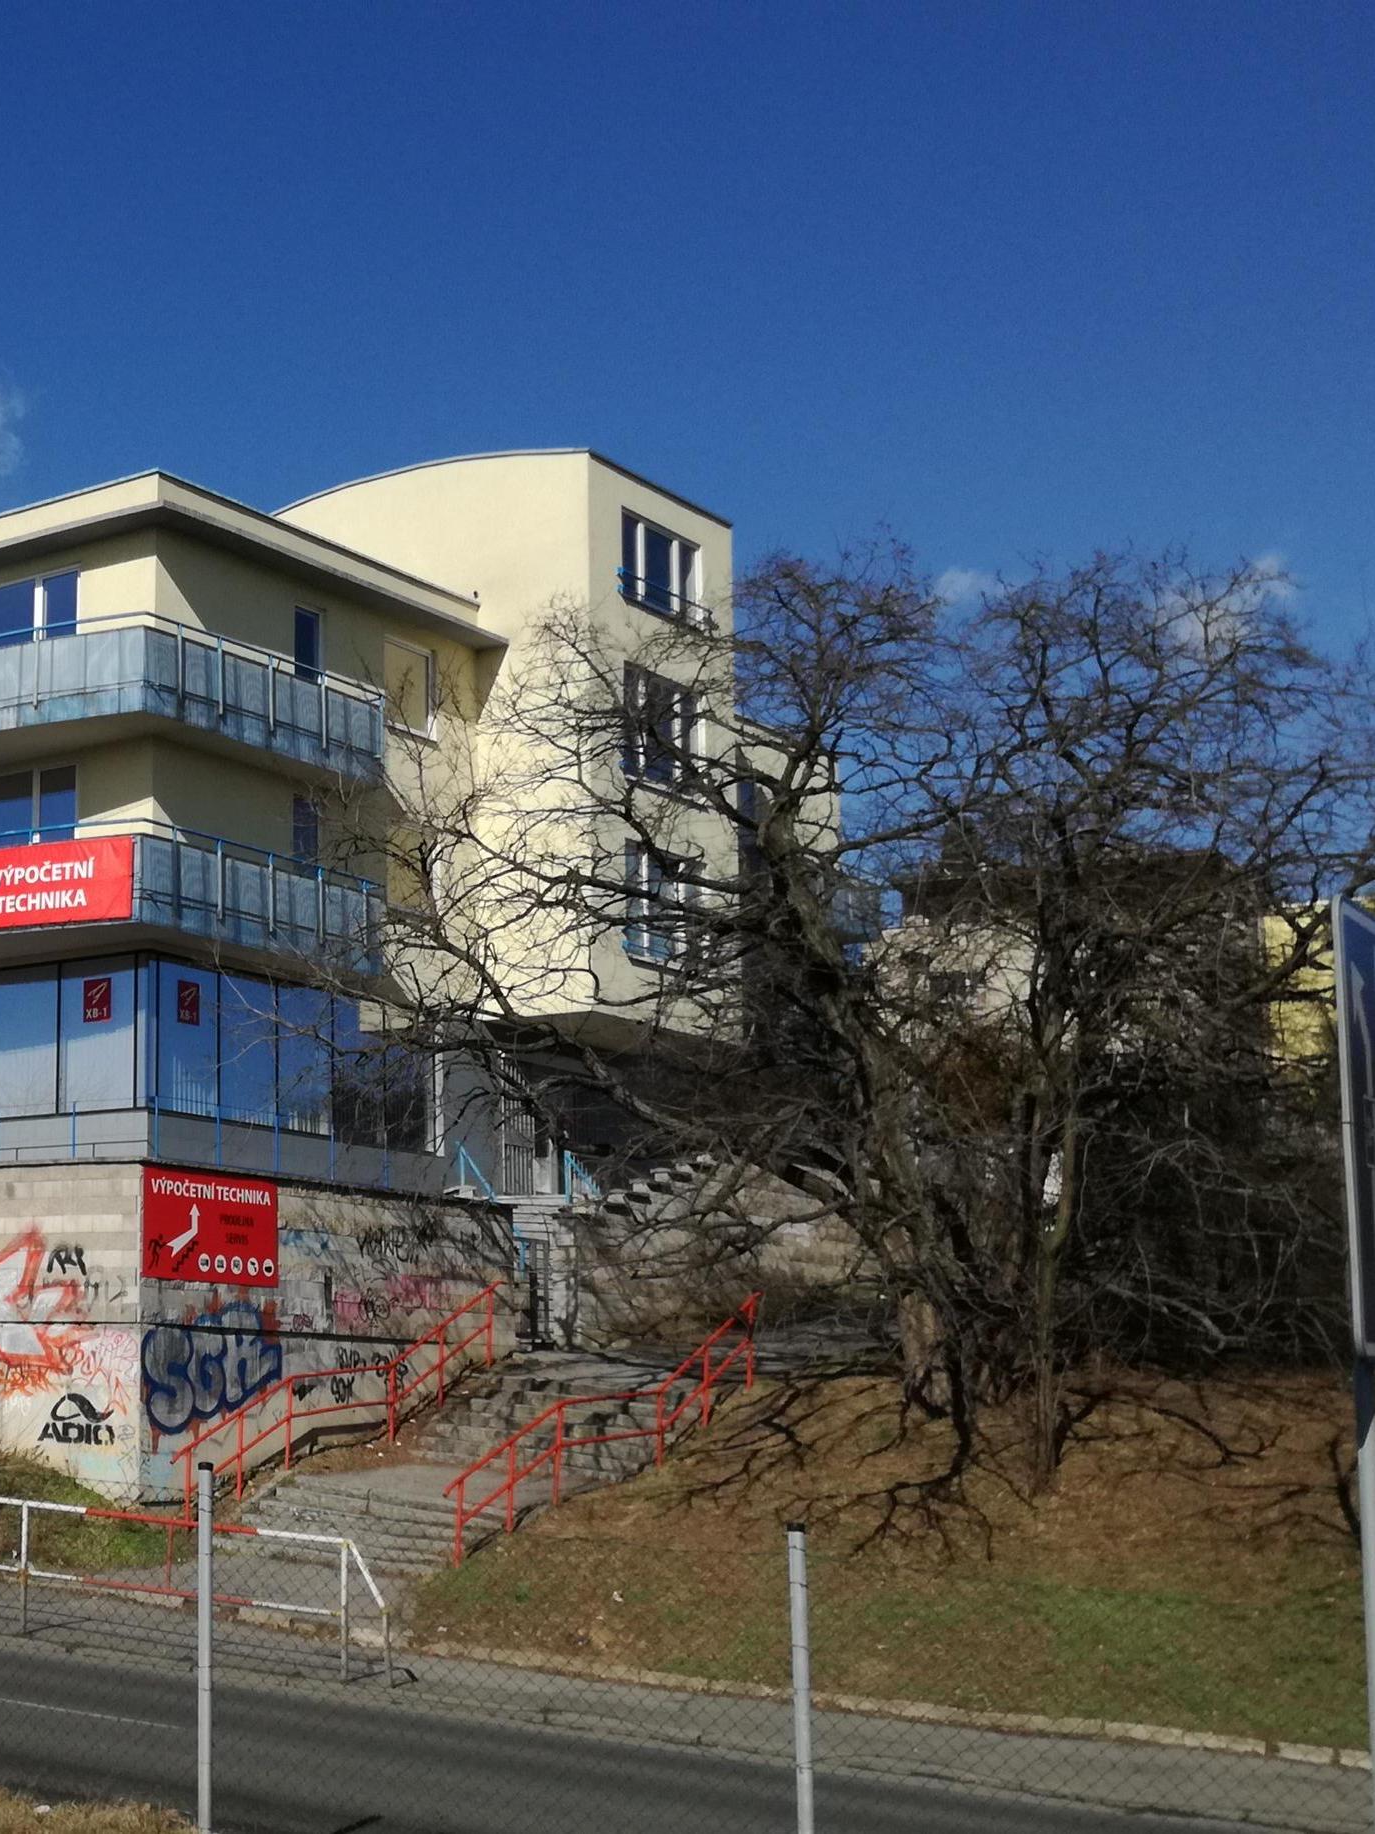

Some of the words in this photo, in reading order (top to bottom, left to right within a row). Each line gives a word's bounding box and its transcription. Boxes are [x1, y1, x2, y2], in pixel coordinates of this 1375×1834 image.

[85, 1007, 107, 1020] XB-1
[179, 1009, 198, 1022] XB-1
[151, 1176, 217, 1200] VÝPOČETNÍ
[216, 1185, 272, 1206] TECHNIKA
